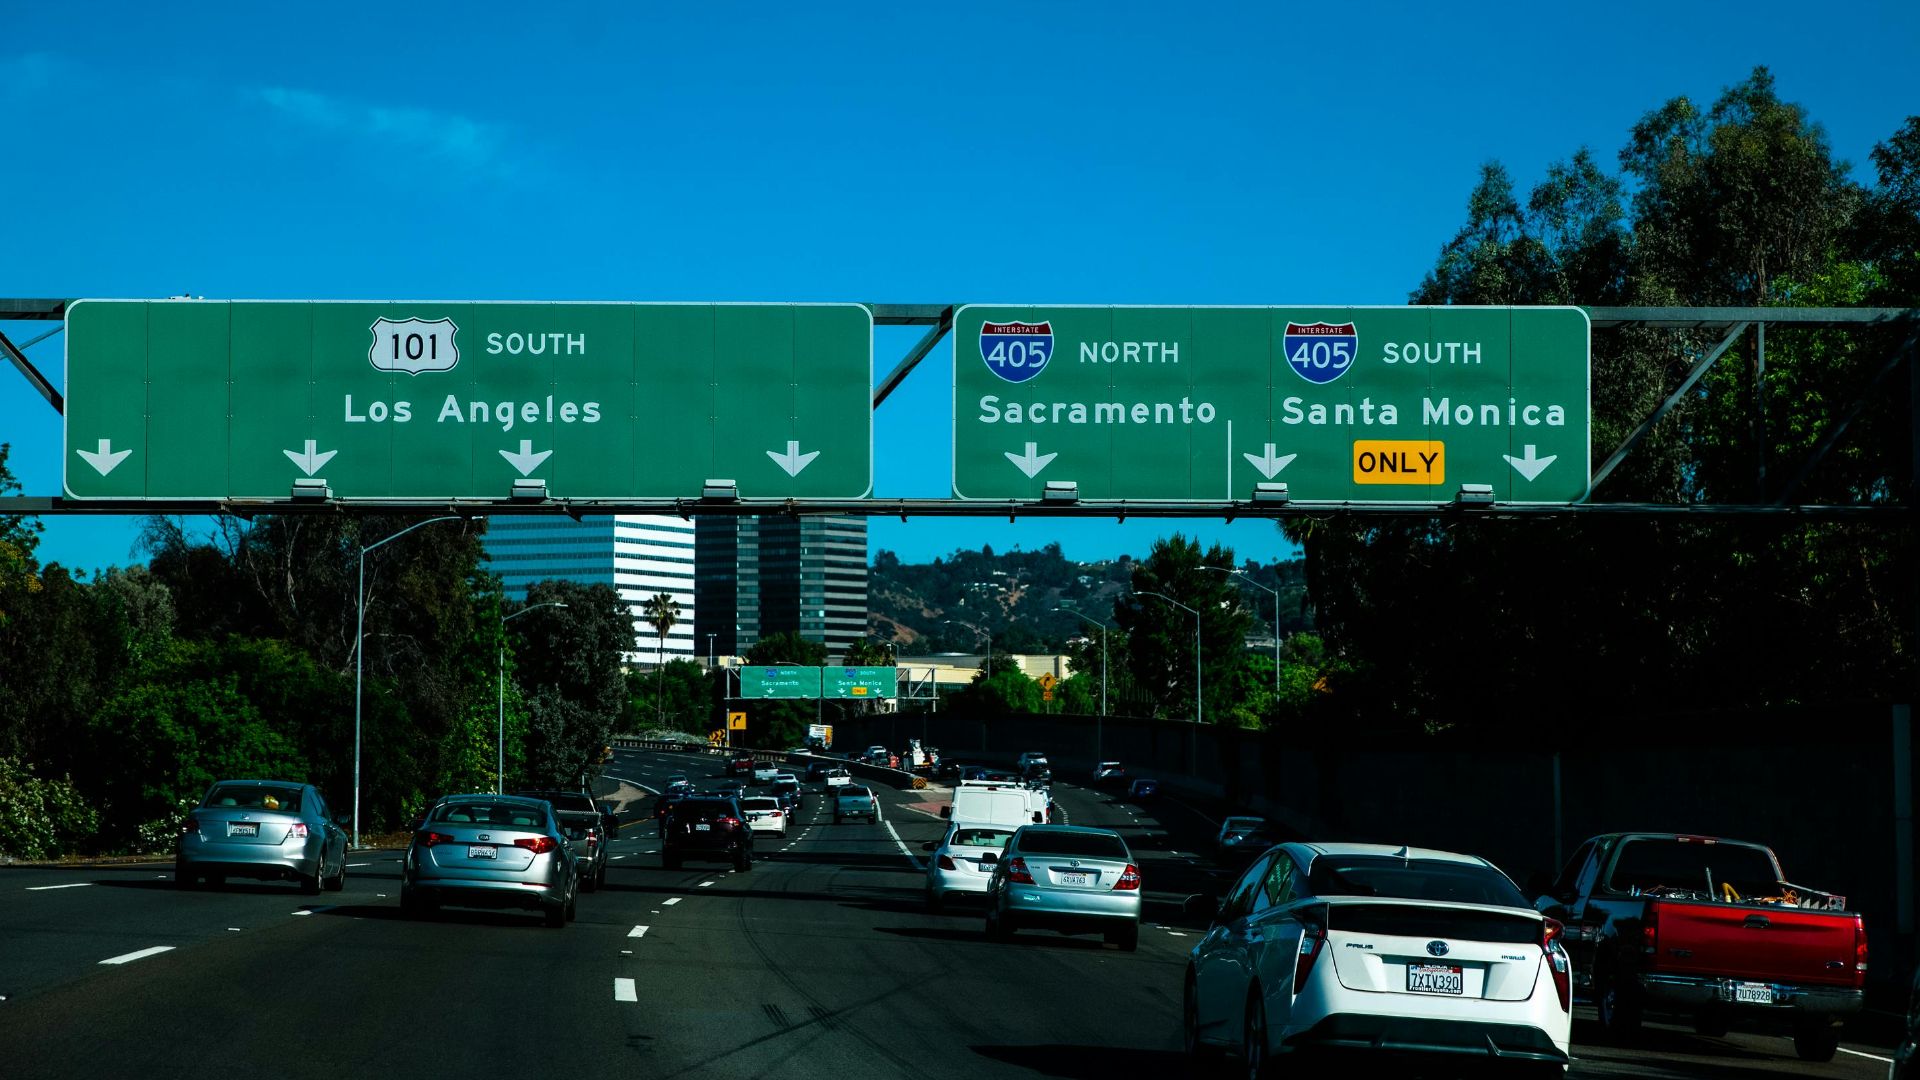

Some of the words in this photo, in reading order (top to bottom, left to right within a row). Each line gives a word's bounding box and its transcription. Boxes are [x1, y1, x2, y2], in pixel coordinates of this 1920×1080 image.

[994, 326, 1039, 334] INTERSTATE
[1298, 327, 1343, 335] INTERSTATE
[392, 333, 437, 360] 101
[486, 332, 585, 355] SOUTH
[987, 341, 1046, 368] 405
[1080, 342, 1179, 363] NORTH
[1382, 342, 1481, 364] SOUTH
[1291, 342, 1350, 369] 405
[345, 394, 412, 423] Los
[437, 394, 601, 432] Angeles
[978, 395, 1216, 424] Sacramento
[1281, 396, 1398, 425] Santa
[1423, 397, 1565, 426] Monica
[1358, 451, 1439, 473] ONLY
[1411, 973, 1459, 990] 7XIV390
